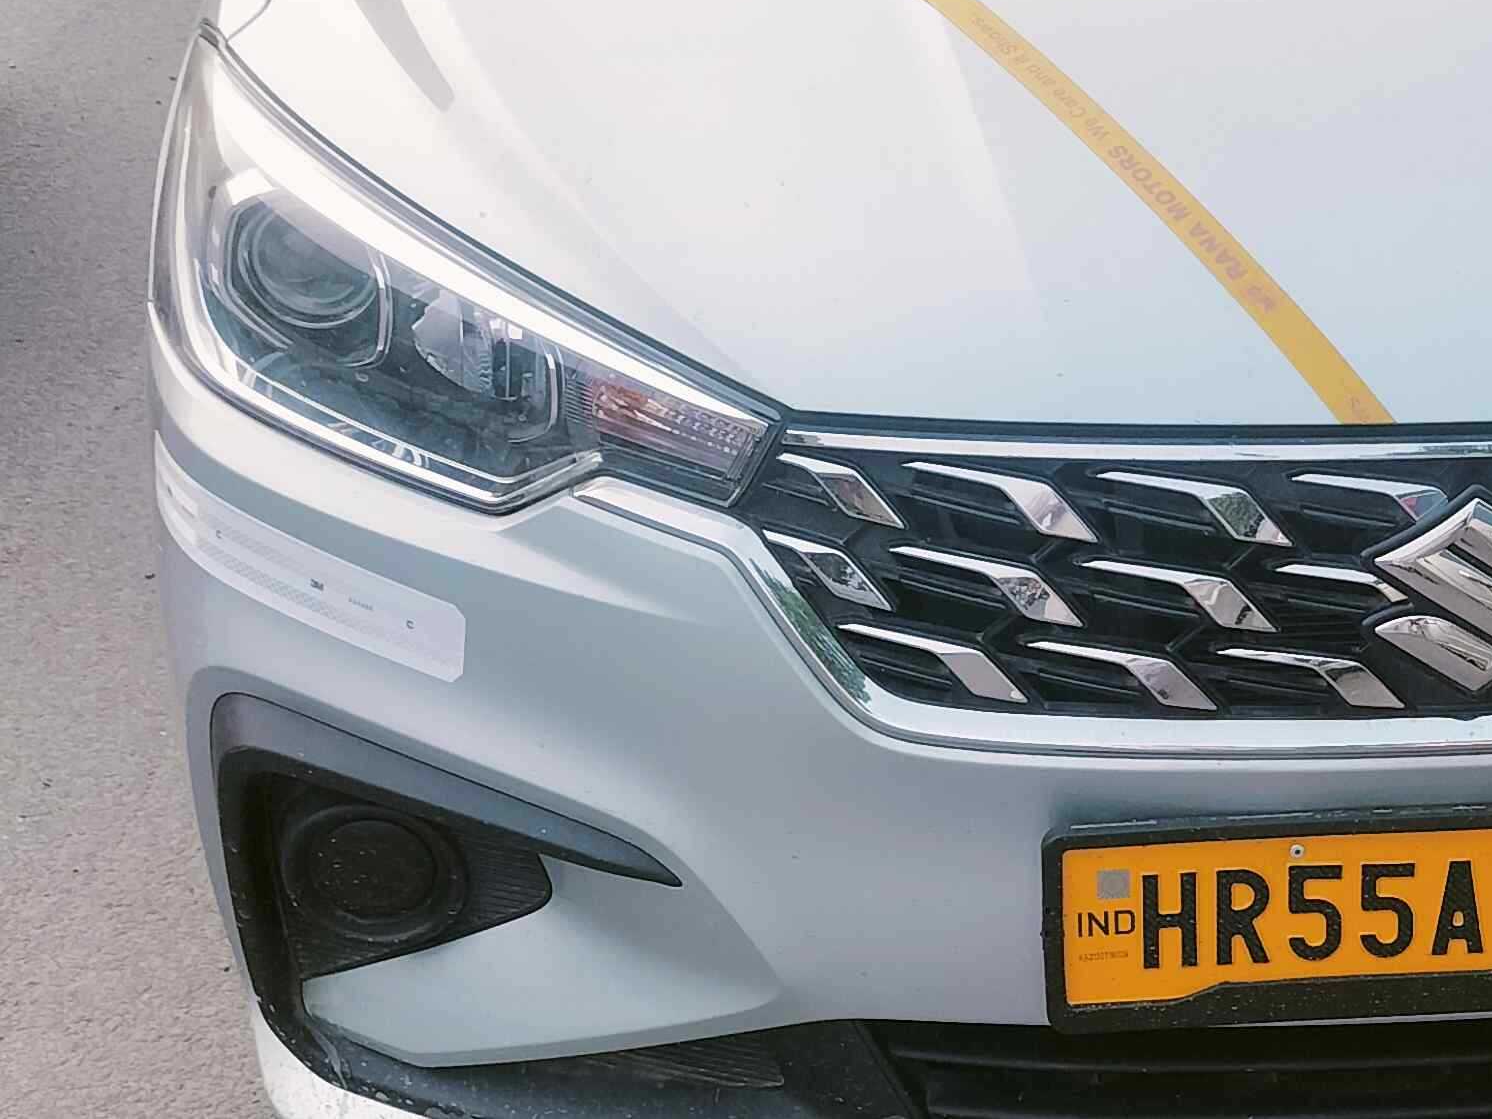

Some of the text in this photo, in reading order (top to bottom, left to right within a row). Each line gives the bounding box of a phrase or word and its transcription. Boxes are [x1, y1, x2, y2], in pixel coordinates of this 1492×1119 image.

[1025, 64, 1057, 86] and
[1053, 89, 1086, 118] Care
[1085, 117, 1110, 141] We
[1108, 145, 1192, 222] MOTORS
[1189, 221, 1248, 280] RANA
[1077, 909, 1136, 939] IND
